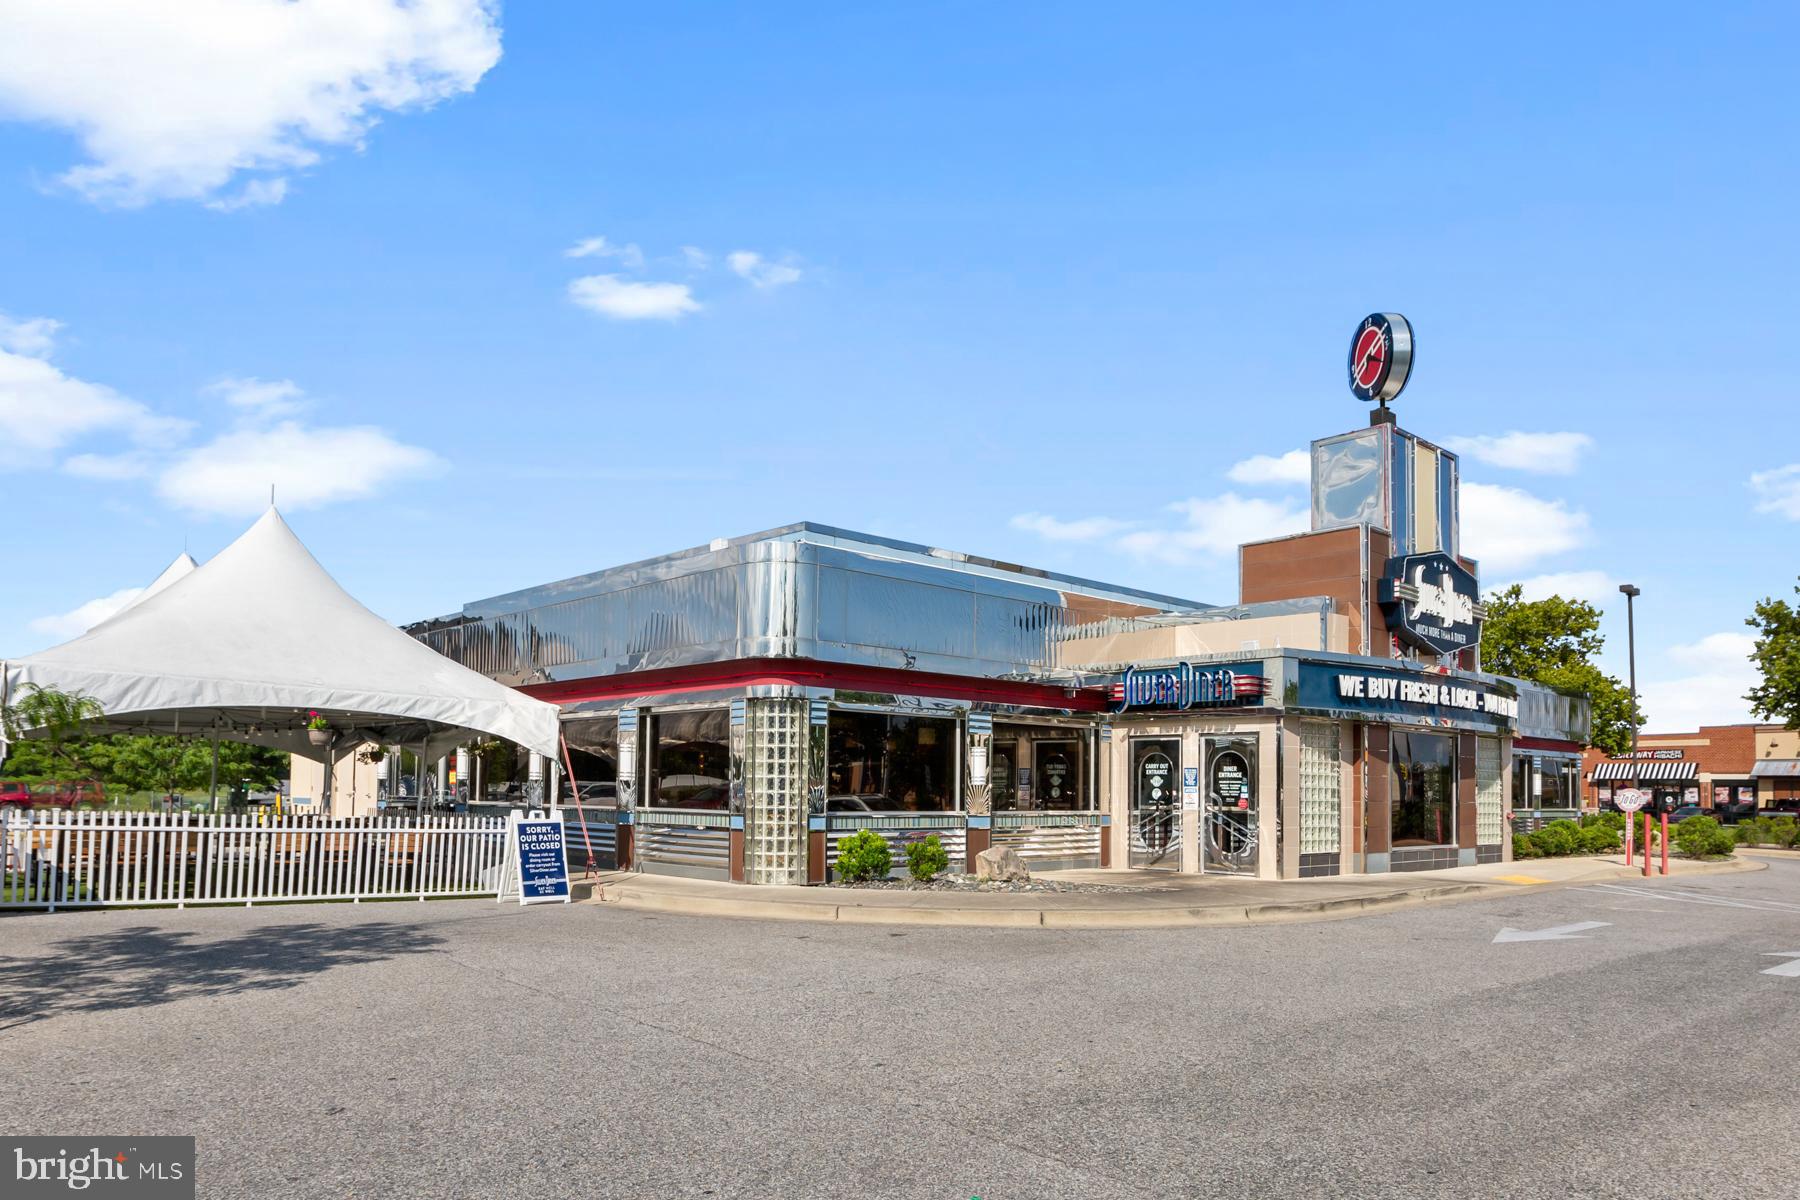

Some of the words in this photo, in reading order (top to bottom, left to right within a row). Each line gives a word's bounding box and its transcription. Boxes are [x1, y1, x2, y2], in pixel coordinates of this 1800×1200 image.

[1416, 624, 1428, 636] MUCH
[1428, 626, 1440, 638] MORE
[1451, 632, 1454, 641] A
[1454, 632, 1466, 644] DINER
[1112, 664, 1178, 714] SILVER
[1178, 662, 1236, 710] DINER
[1338, 674, 1364, 698] WE
[1368, 676, 1398, 700] BUY
[1401, 680, 1438, 705] FRESH
[1440, 684, 1450, 706] &
[1451, 686, 1478, 710] LOCAL
